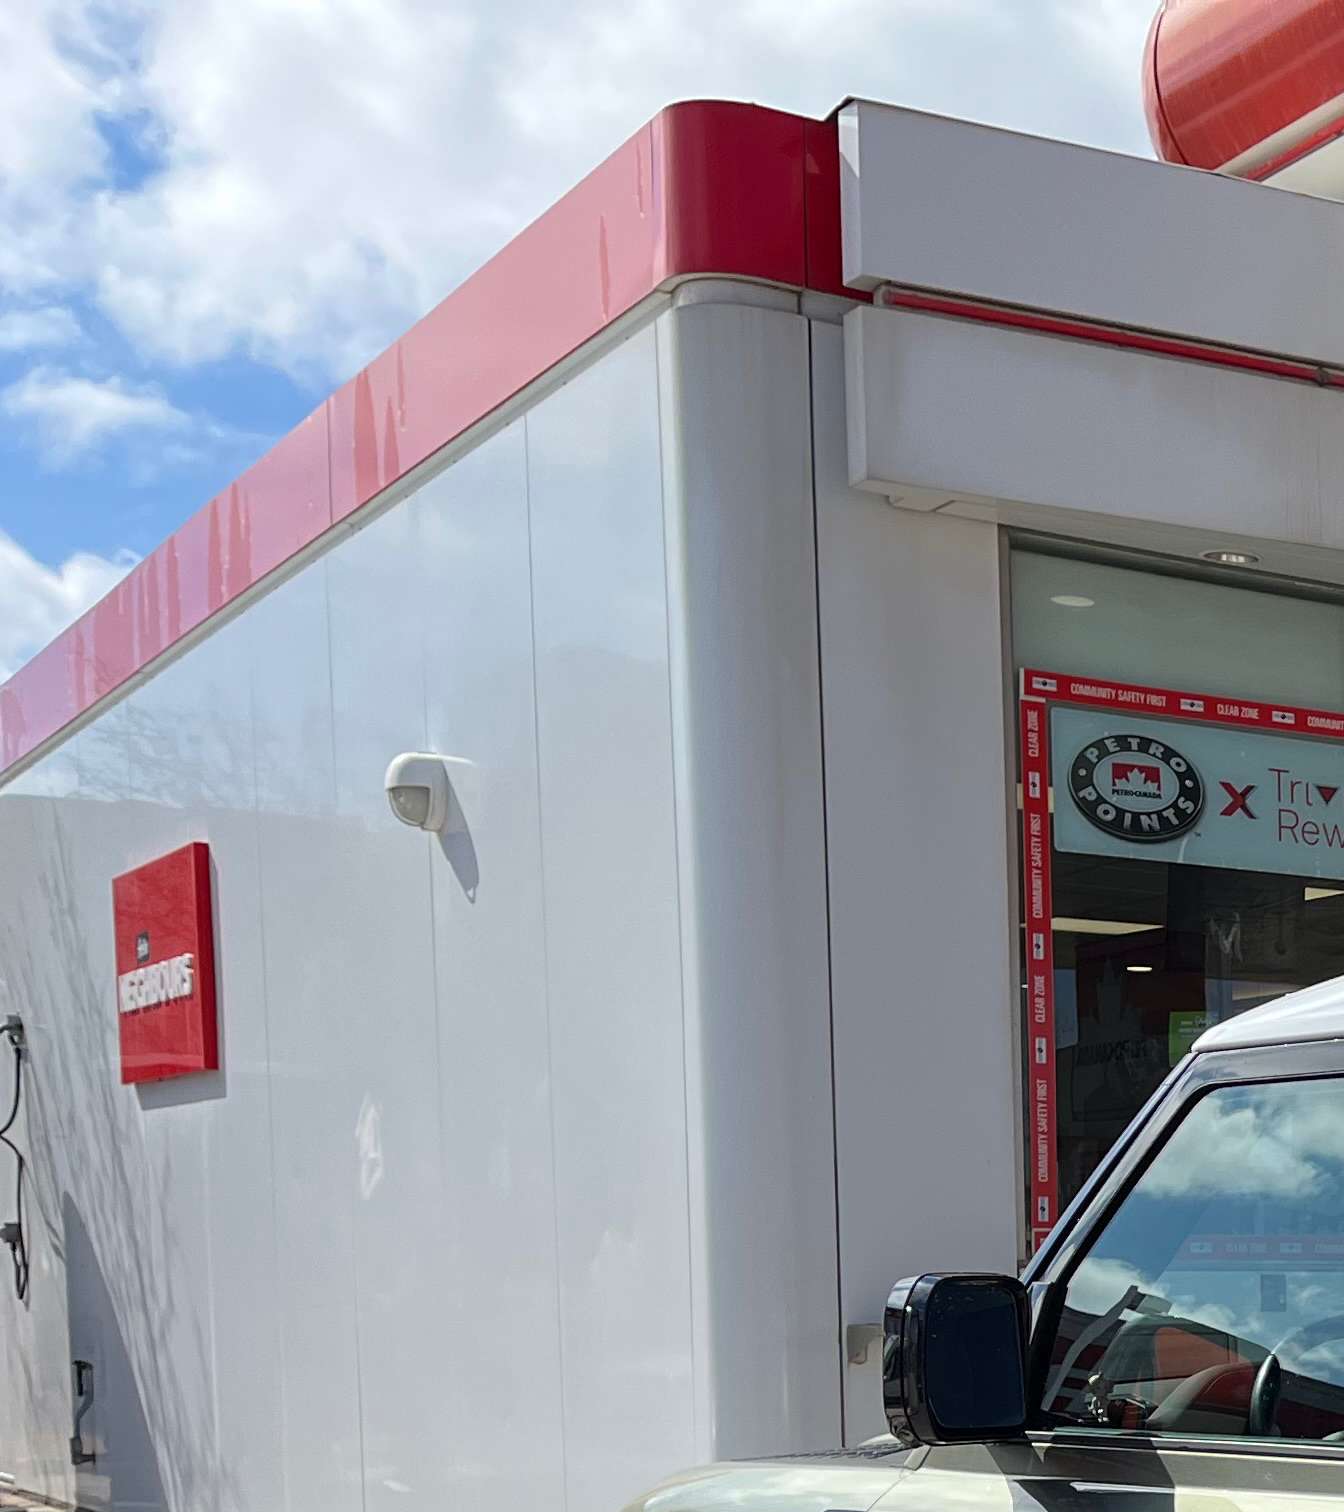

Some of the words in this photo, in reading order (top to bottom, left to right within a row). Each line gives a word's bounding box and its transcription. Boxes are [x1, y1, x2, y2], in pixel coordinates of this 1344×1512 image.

[1070, 683, 1117, 700] COMMUNITY
[1027, 709, 1038, 732] ZONE
[1216, 703, 1240, 717] CLEAR
[1240, 706, 1260, 720] ZONE
[1028, 731, 1040, 757] CLEAR
[1084, 737, 1188, 774] PETRO
[1078, 785, 1196, 832] POINTS
